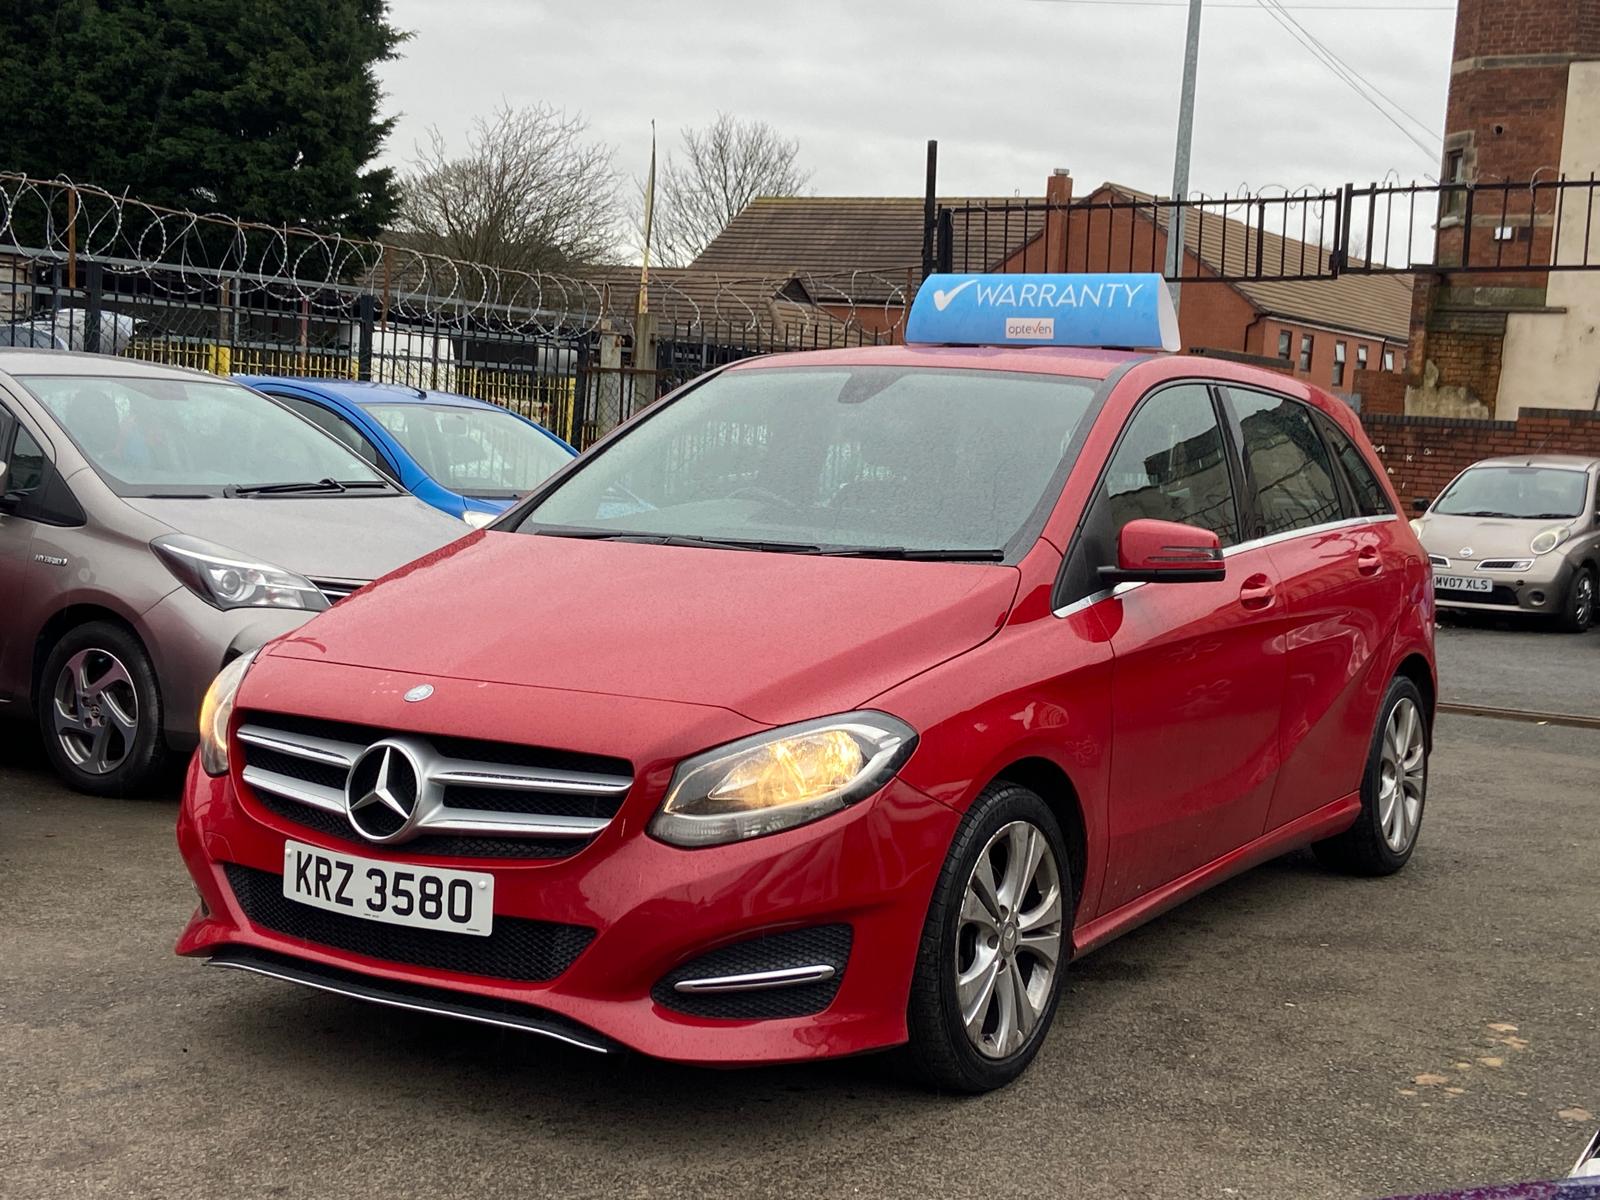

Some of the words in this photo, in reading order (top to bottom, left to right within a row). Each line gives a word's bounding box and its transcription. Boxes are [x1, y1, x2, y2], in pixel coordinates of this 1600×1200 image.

[976, 283, 1143, 307] WARRANTY
[1008, 320, 1052, 336] opteven
[1435, 576, 1463, 588] MV07
[1466, 579, 1488, 590] XLS
[295, 850, 354, 907] KRZ
[366, 868, 473, 924] 3580
